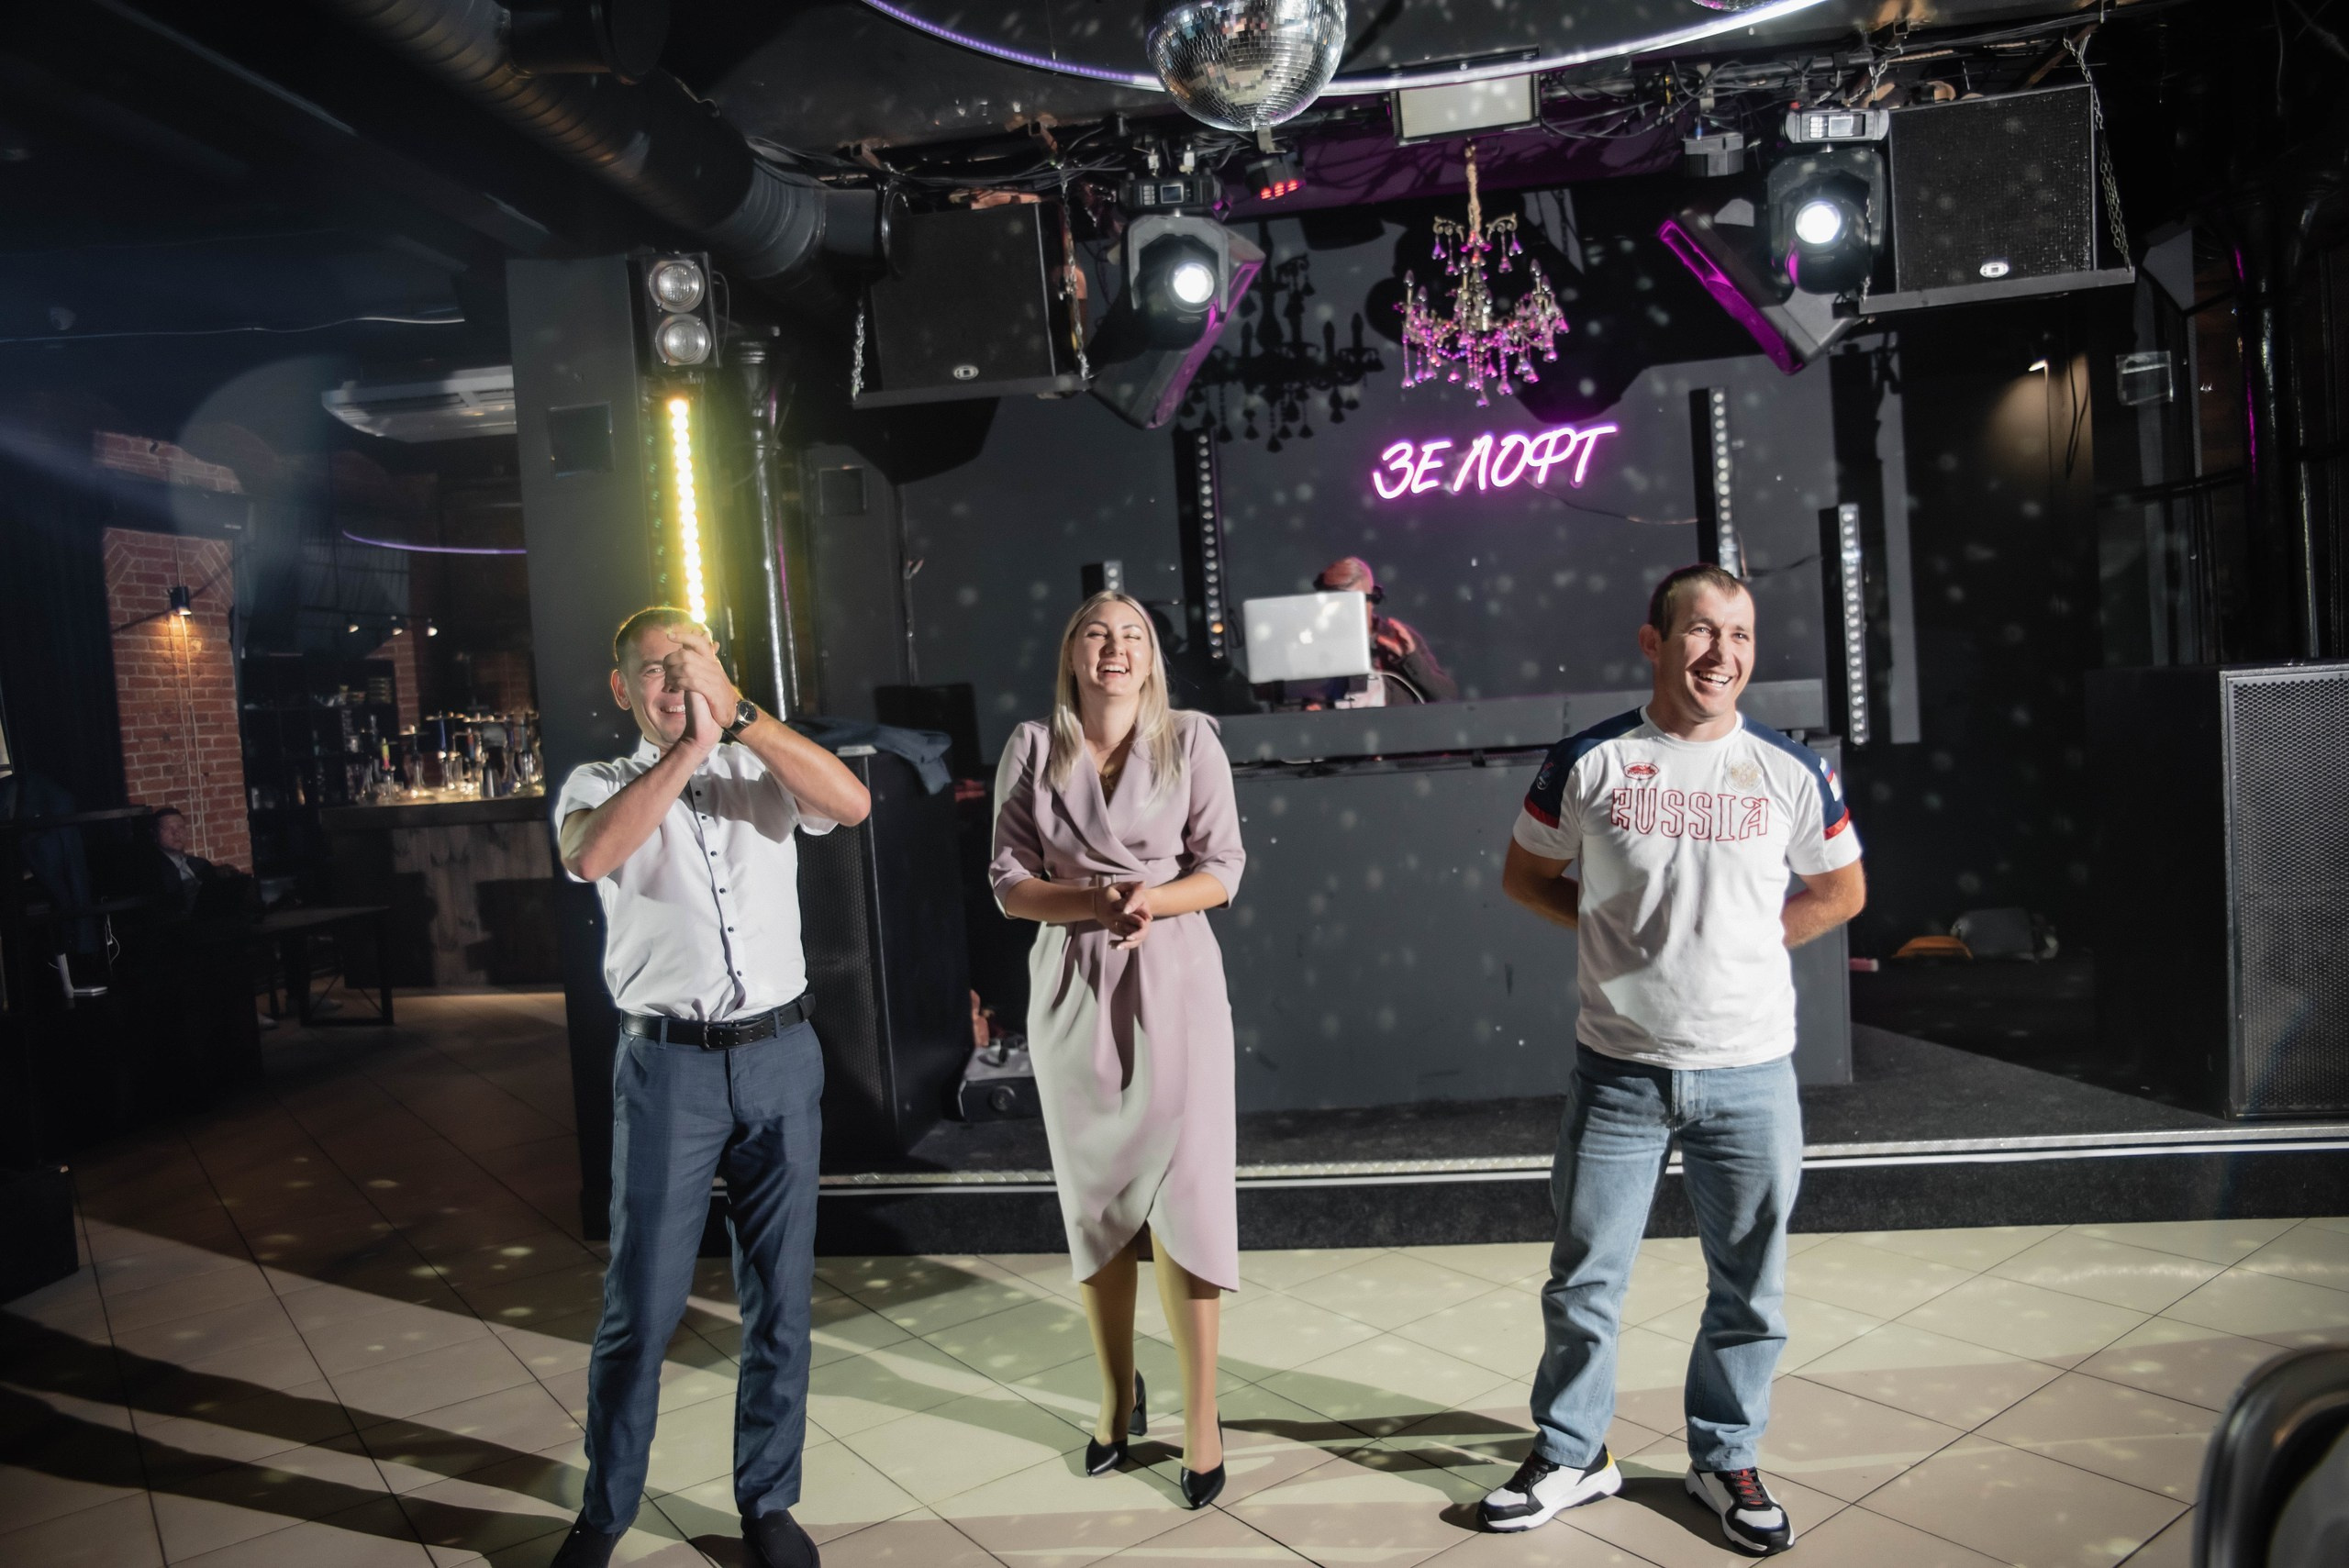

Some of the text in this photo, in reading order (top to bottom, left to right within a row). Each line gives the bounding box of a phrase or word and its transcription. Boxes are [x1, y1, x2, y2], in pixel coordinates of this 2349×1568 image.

[1373, 425, 1618, 499] ЗЕ ЛОФТ
[1610, 787, 1769, 841] RUSSIA
